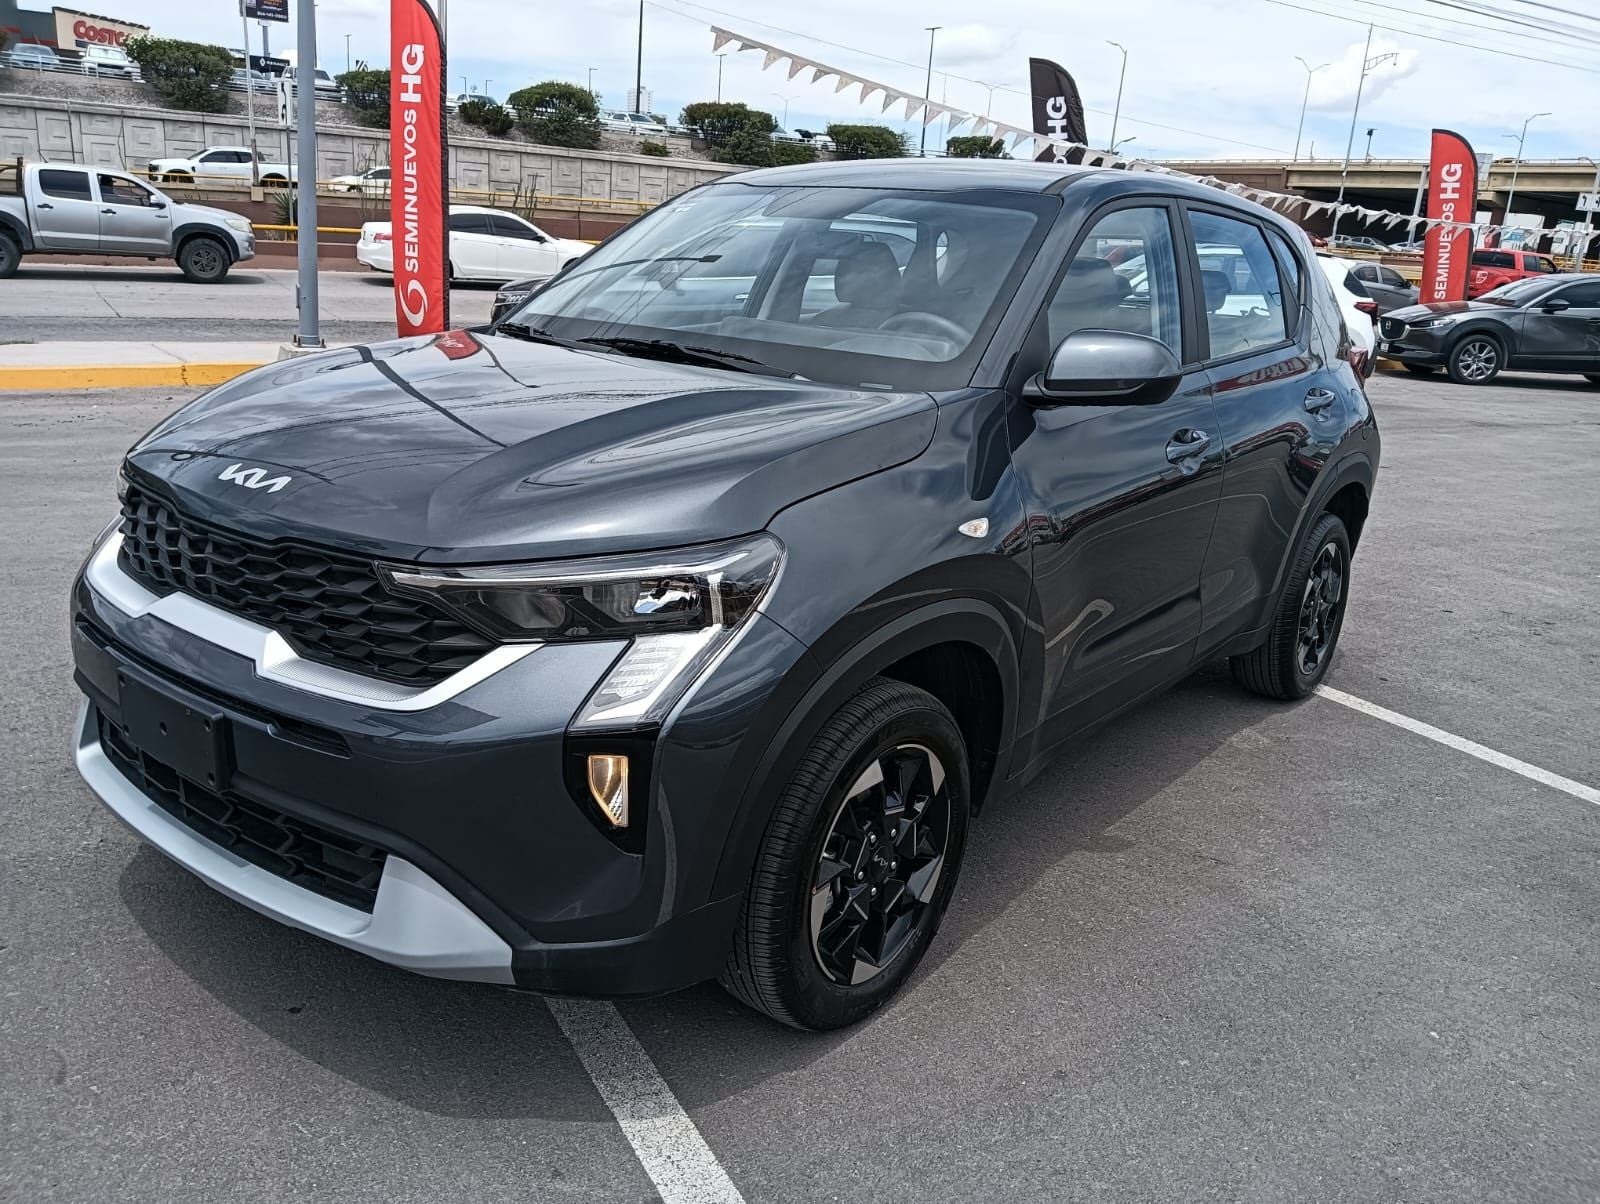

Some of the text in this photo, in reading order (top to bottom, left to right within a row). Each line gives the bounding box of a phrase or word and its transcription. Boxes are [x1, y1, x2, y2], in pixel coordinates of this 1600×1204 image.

[73, 20, 130, 47] COSTC
[1046, 96, 1067, 139] HG
[400, 43, 424, 273] SEMINUEVOS HG
[1440, 163, 1462, 199] HG
[218, 462, 292, 494] KIA
